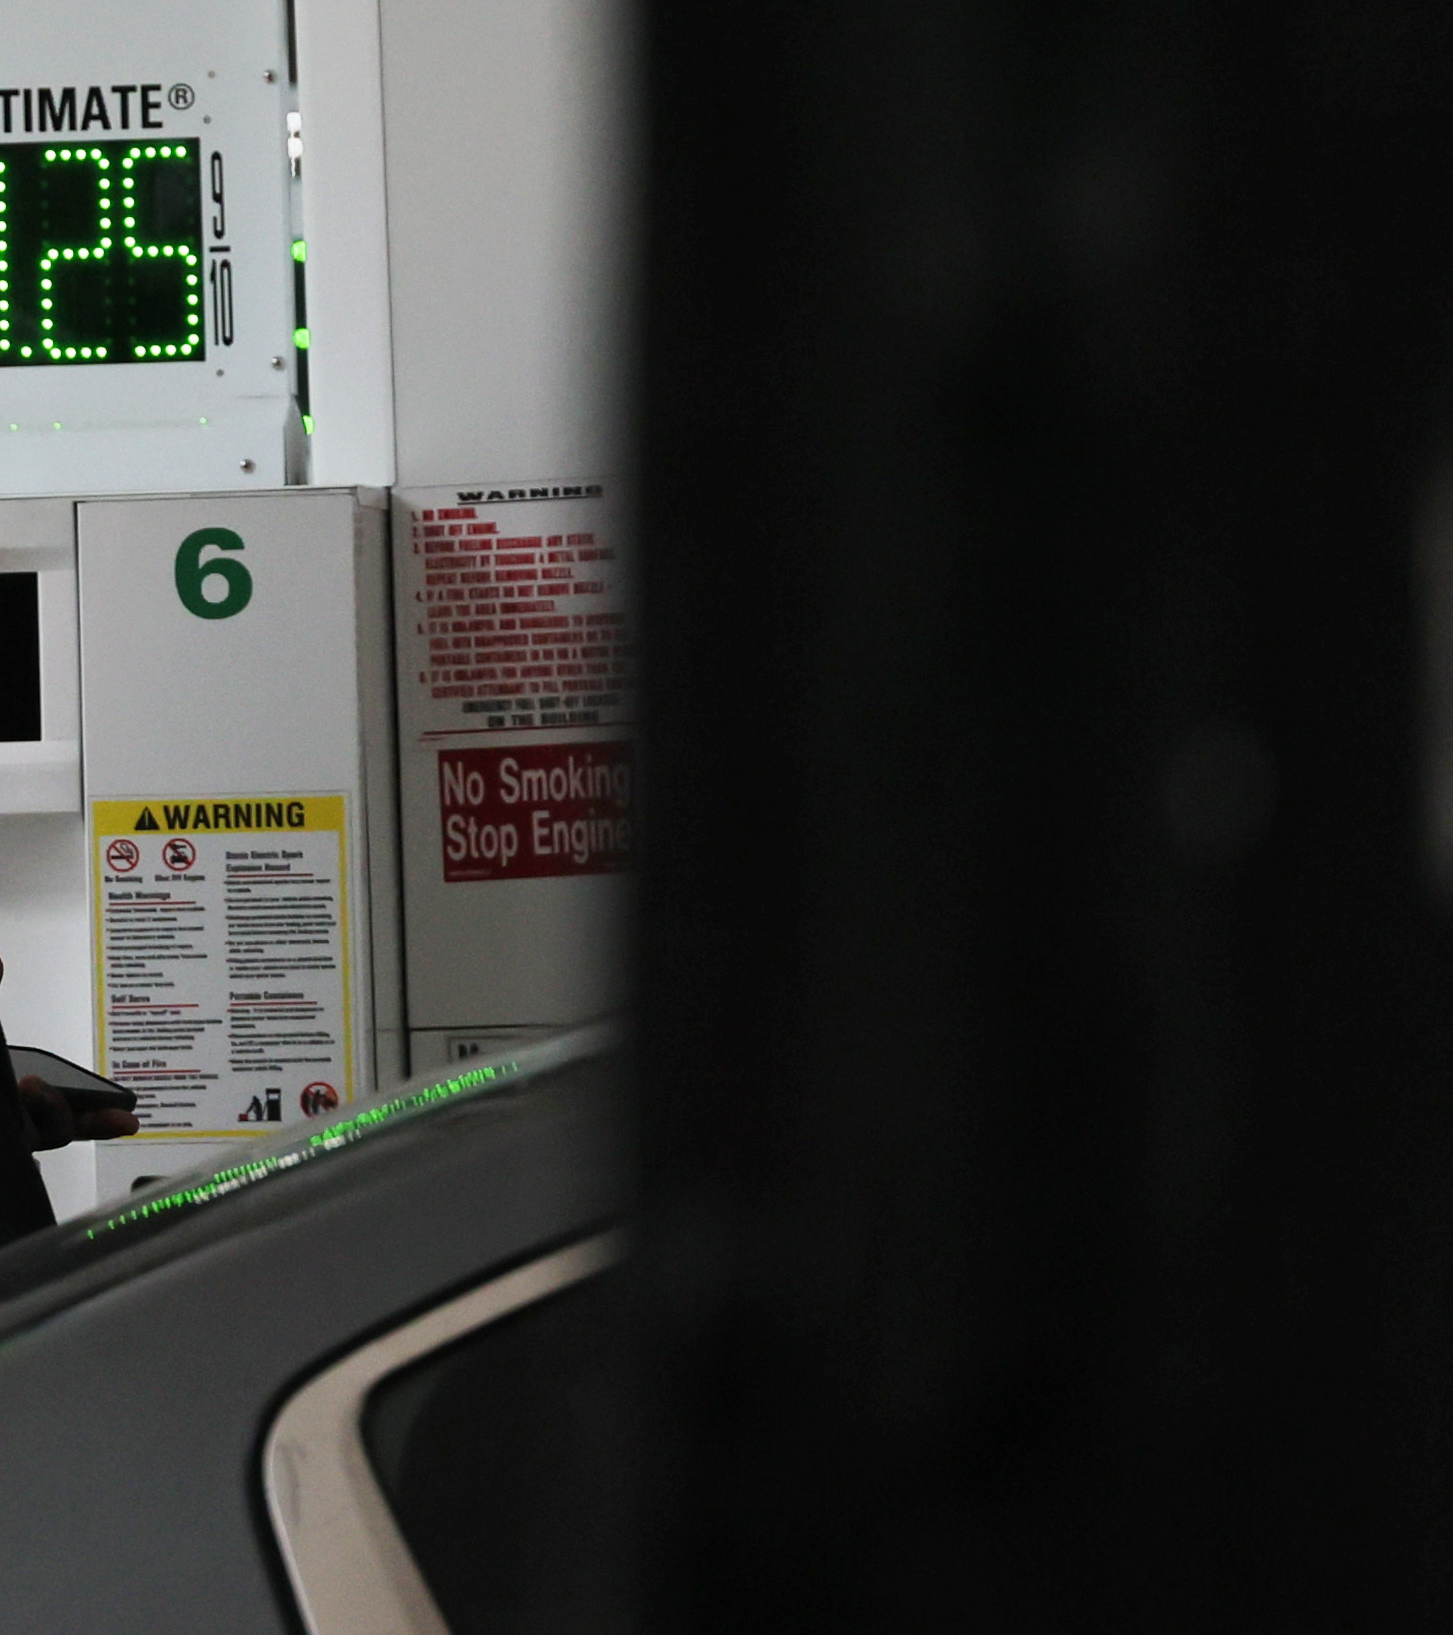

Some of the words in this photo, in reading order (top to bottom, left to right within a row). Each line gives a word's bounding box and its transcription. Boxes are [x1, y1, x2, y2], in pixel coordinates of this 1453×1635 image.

[457, 485, 603, 501] WARNING
[173, 527, 253, 619] 6
[442, 760, 485, 806] No
[498, 754, 631, 805] Smoking
[163, 801, 306, 831] WARNING
[445, 812, 518, 867] Stop
